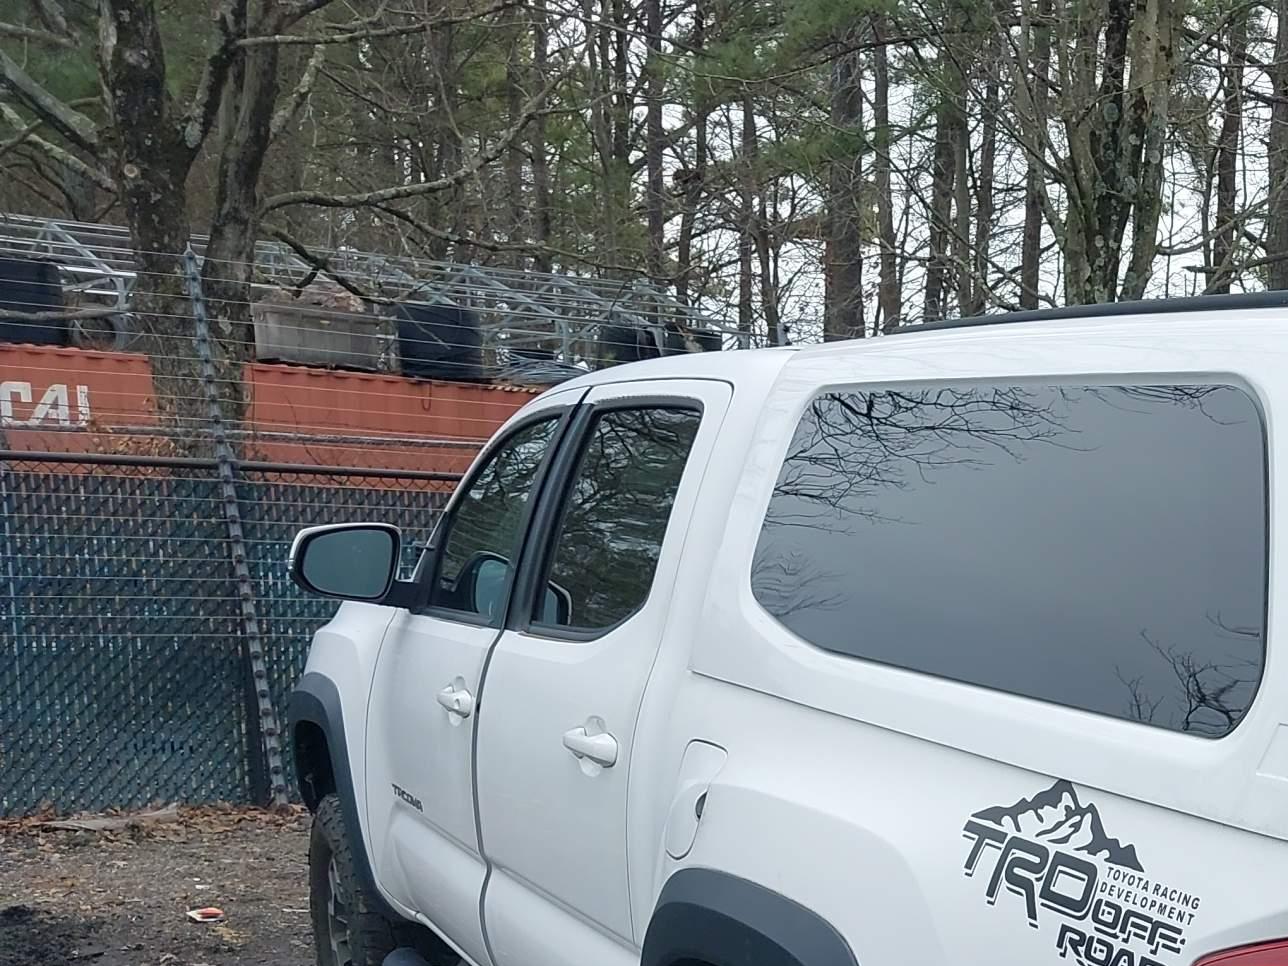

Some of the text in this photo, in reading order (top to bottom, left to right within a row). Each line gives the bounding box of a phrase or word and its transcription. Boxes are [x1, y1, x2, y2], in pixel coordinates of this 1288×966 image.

[962, 819, 1099, 929] TRD
[1107, 866, 1202, 911] TOYOTA RACING
[1091, 898, 1187, 956] OFF
[1099, 881, 1197, 927] DEVELOPMENT
